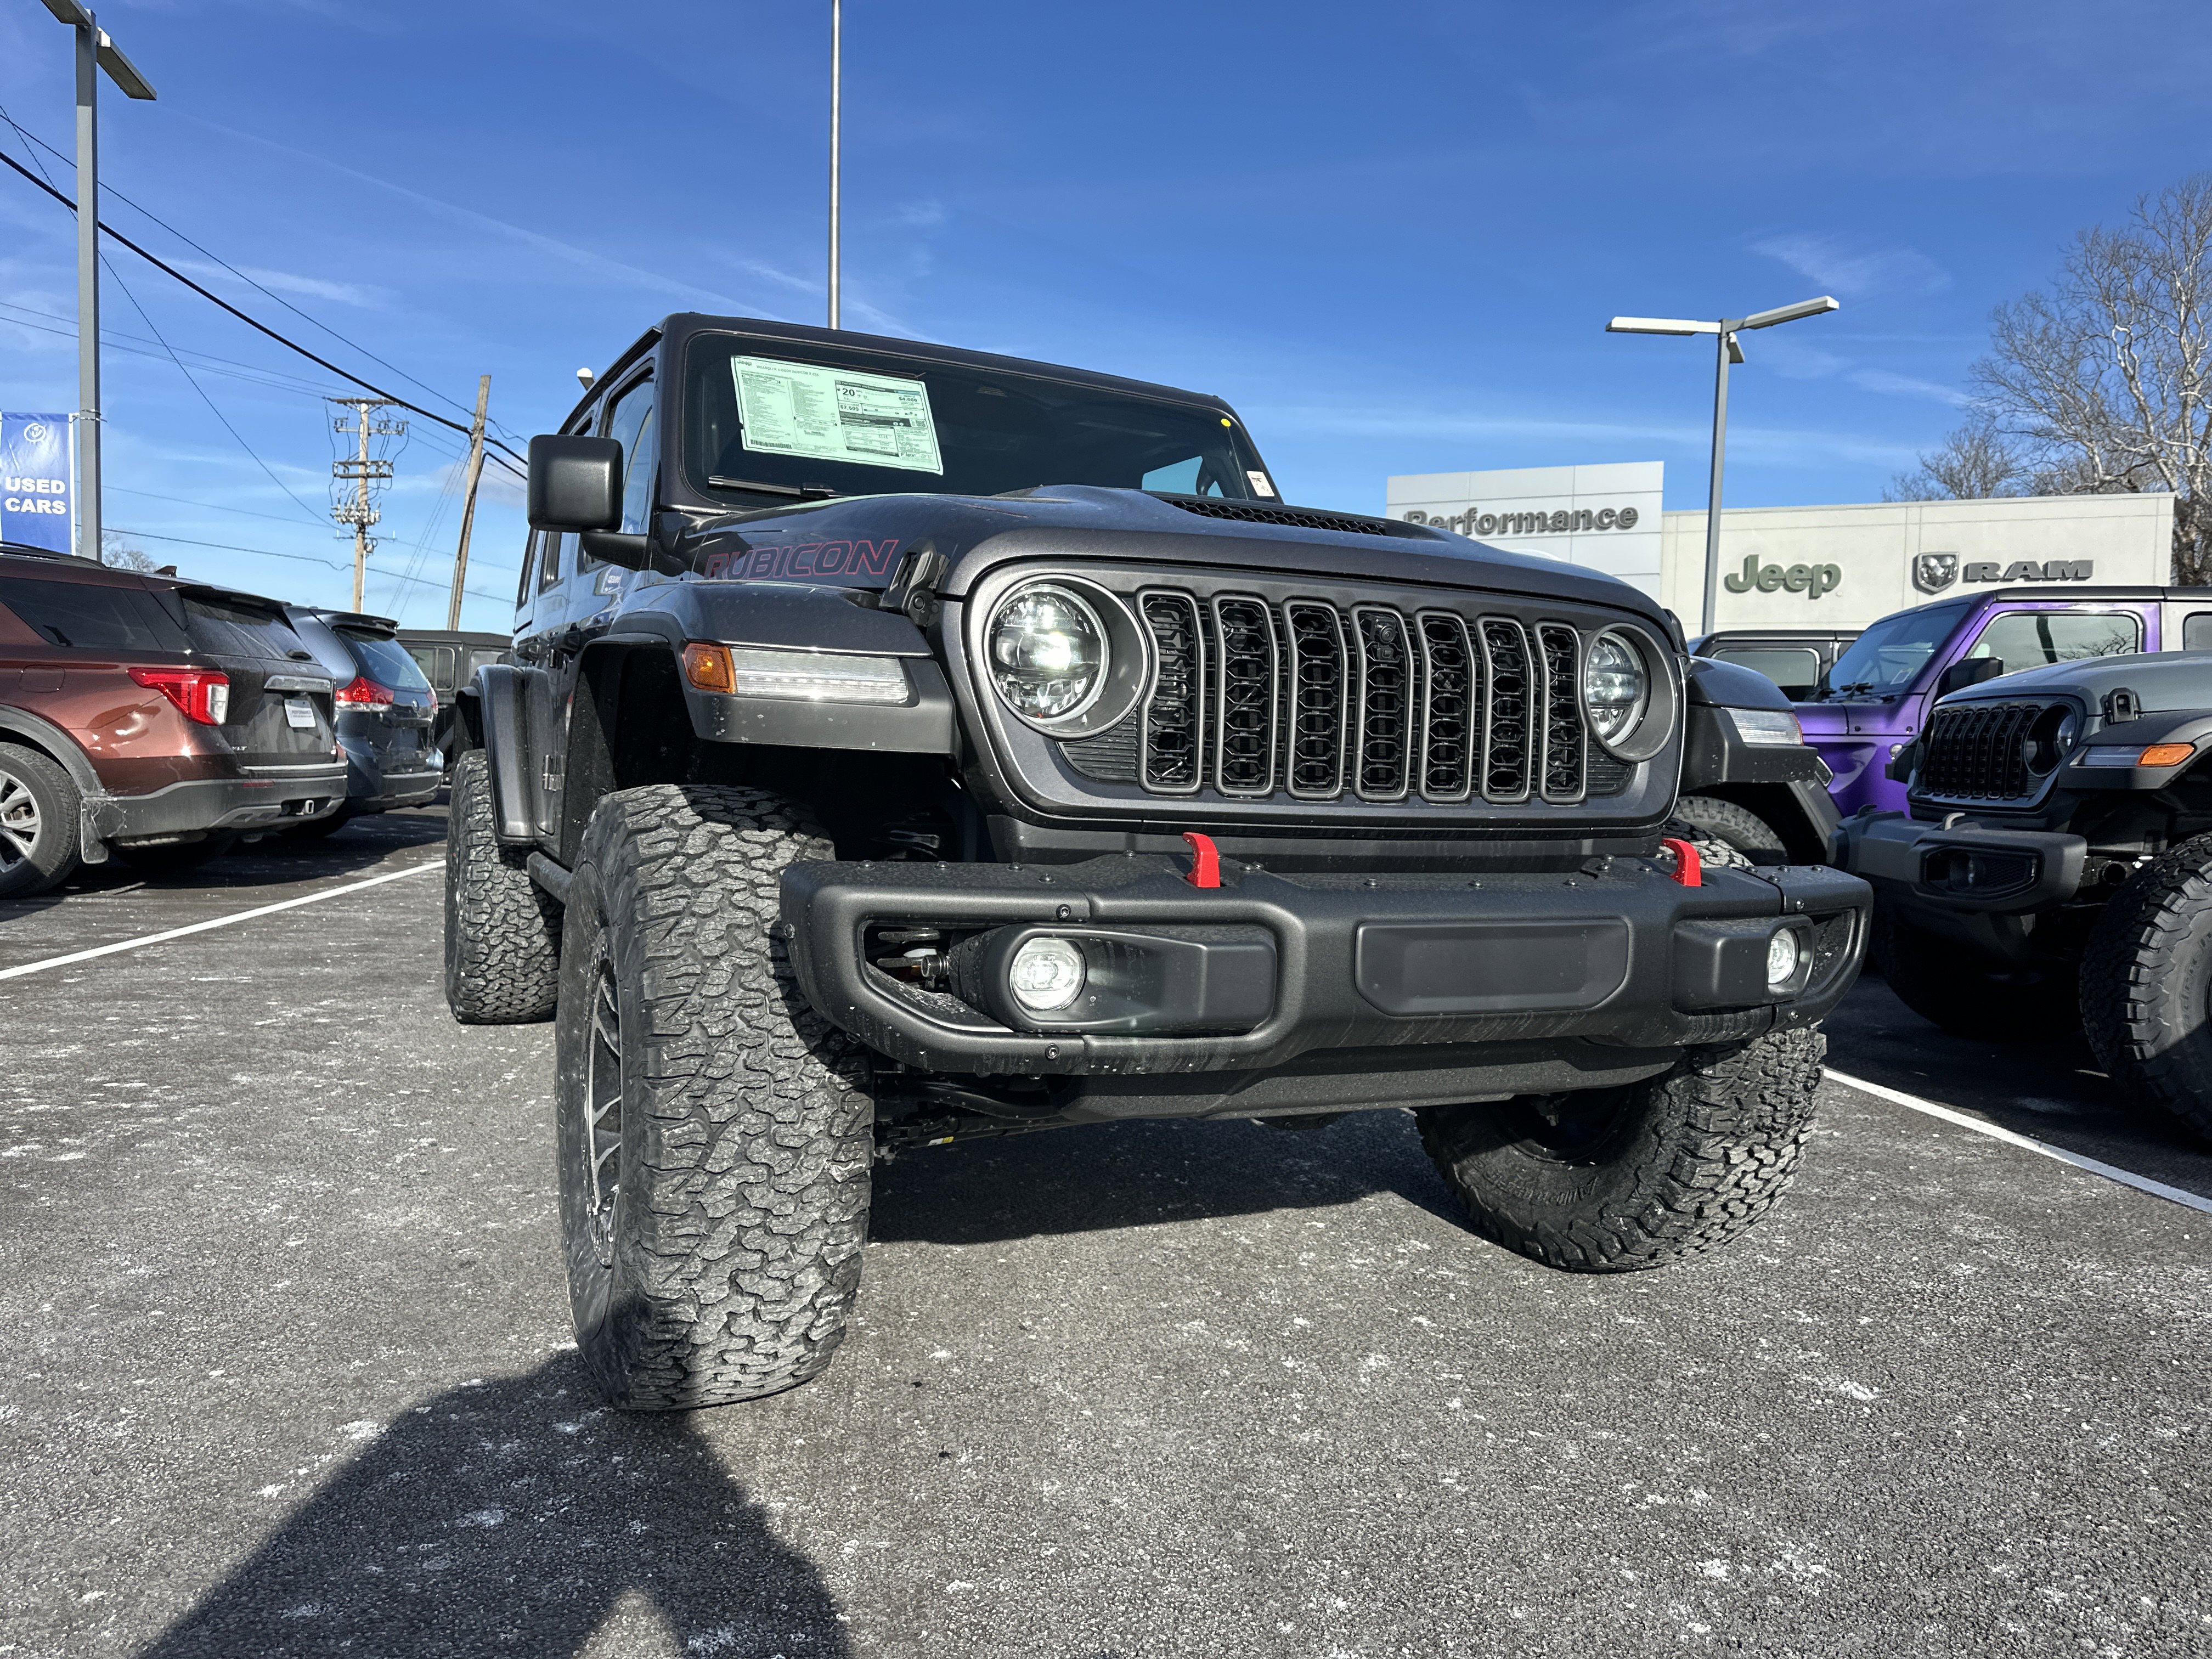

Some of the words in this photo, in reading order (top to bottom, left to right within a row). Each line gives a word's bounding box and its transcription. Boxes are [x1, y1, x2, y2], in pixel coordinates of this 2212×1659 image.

[842, 388, 855, 397] 20
[5, 477, 65, 494] USED
[5, 498, 66, 515] CARS
[1403, 507, 1639, 535] Performance
[704, 539, 899, 580] RUBICON
[1724, 554, 1842, 600] Jeep
[1962, 560, 2094, 583] RAM
